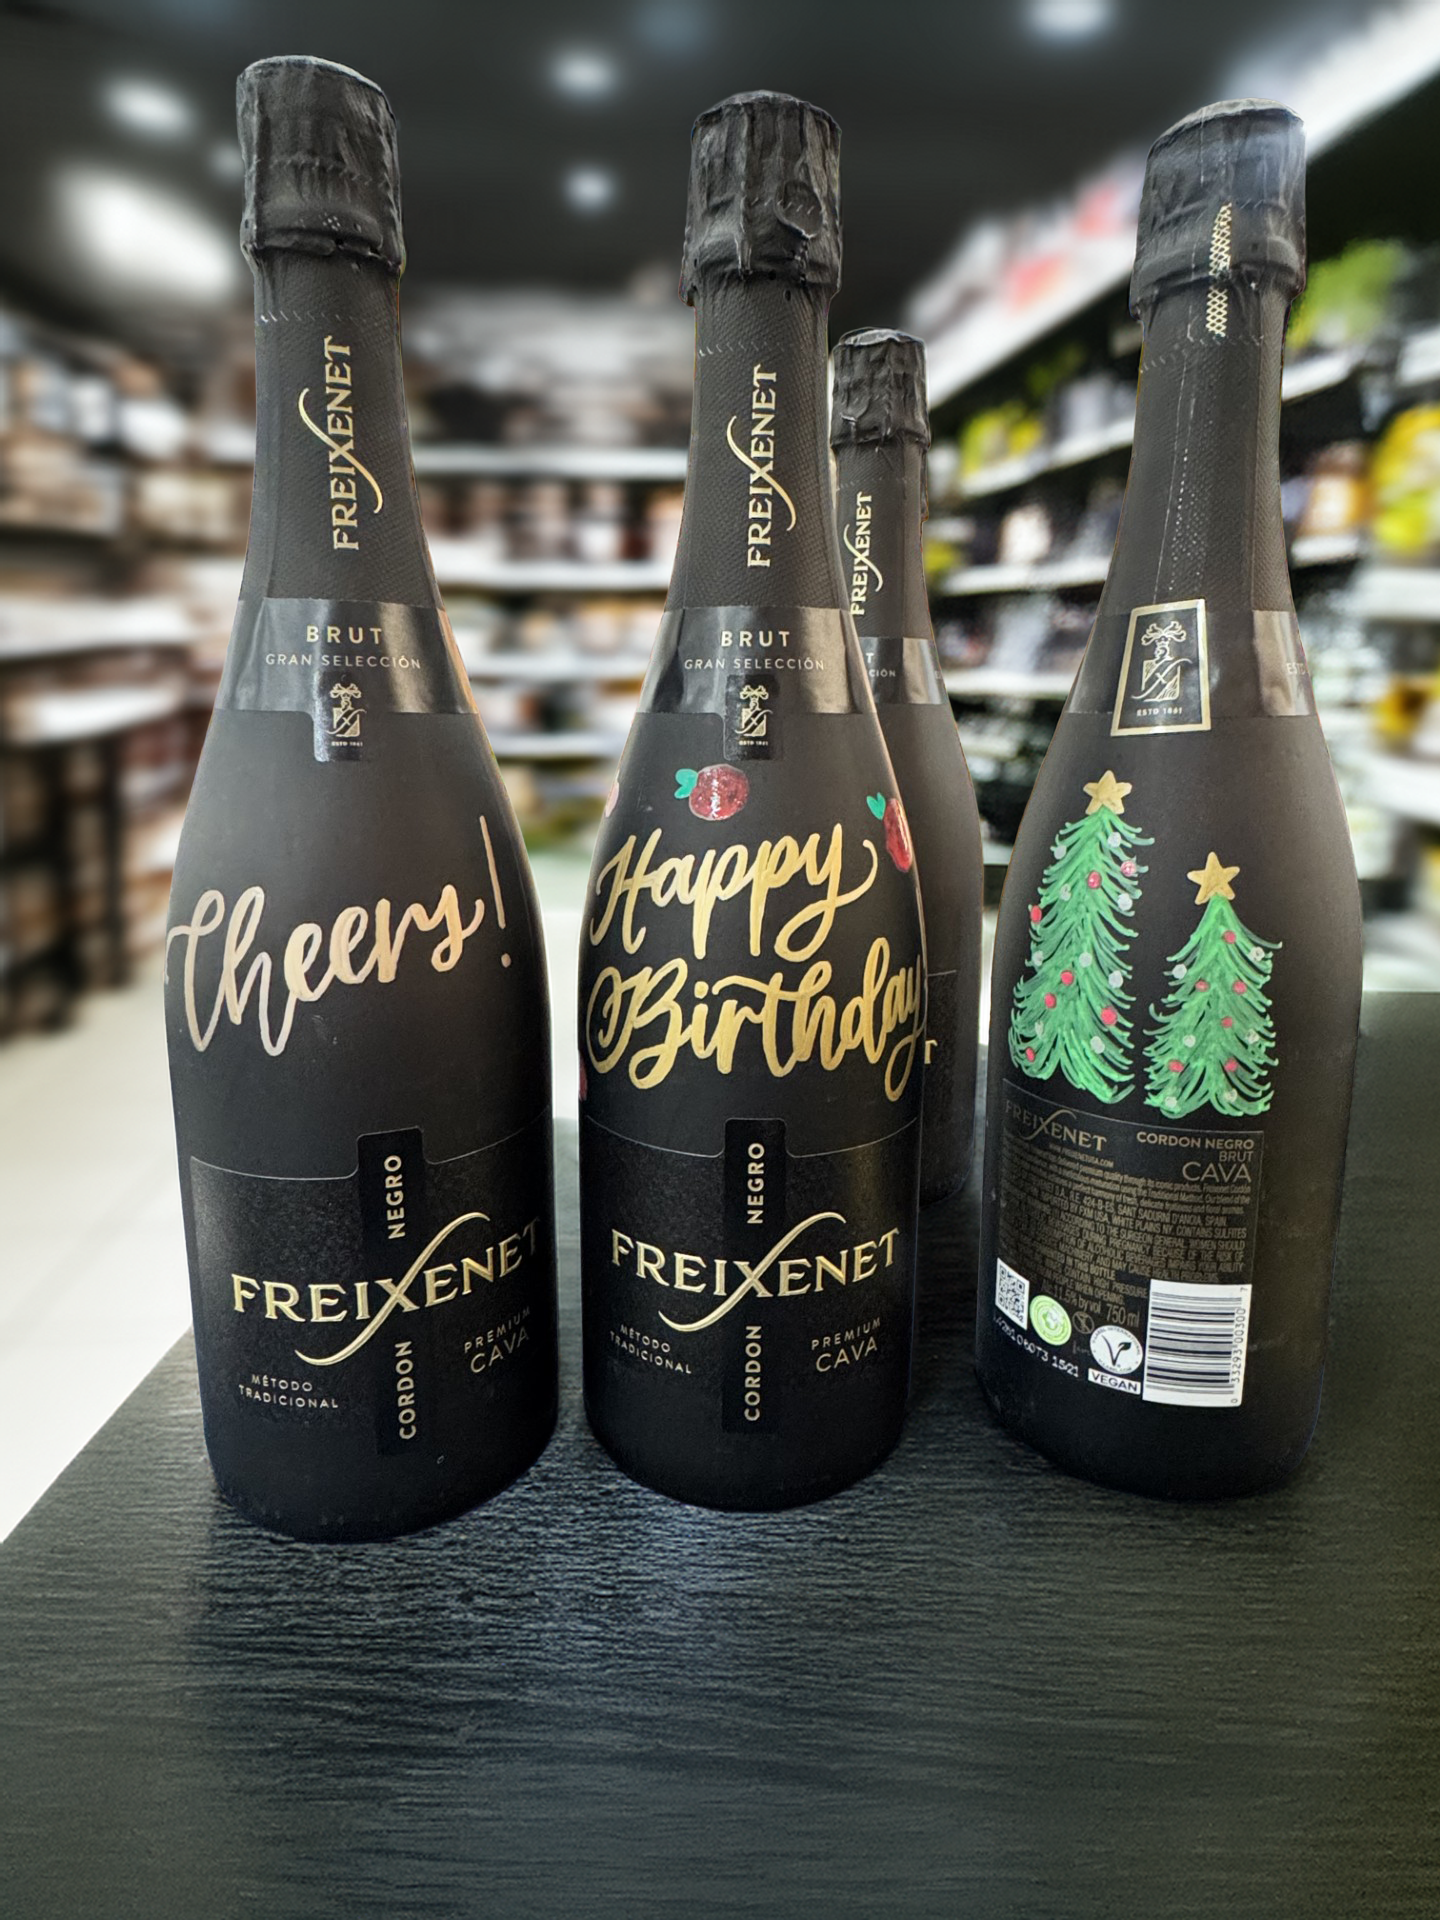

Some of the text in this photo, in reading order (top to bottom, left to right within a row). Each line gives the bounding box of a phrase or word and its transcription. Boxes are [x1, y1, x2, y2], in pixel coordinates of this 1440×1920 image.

[306, 625, 383, 645] BRUT
[721, 630, 791, 648] BRUT
[266, 653, 421, 670] GRAN SELECCIÓN
[684, 656, 825, 671] GRAN SELECCIÓN
[589, 823, 878, 963] Happy
[586, 937, 926, 1102] Birthday
[1005, 1099, 1108, 1152] FREIXENET
[1136, 1131, 1255, 1150] CORDON NEGRO
[1182, 1161, 1252, 1183] CAVA
[1219, 1150, 1254, 1162] BRUT
[384, 1155, 405, 1240] NEGRO
[747, 1143, 765, 1224] NEGRO
[231, 1212, 540, 1366] FREIXENET
[611, 1212, 899, 1332] FREIXENET
[464, 1306, 532, 1354] PREMIUM
[620, 1323, 671, 1353] MÉTODO
[811, 1317, 881, 1350] PREMIUM
[470, 1326, 529, 1374] CAVA
[610, 1331, 692, 1375] TRADICIONAL
[815, 1336, 879, 1373] CAVA
[252, 1374, 313, 1392] MÉTODO
[395, 1341, 416, 1440] CORDON
[744, 1325, 762, 1422] CORDON
[1092, 1370, 1138, 1392] VEGAN
[238, 1384, 339, 1409] TRADICIONAL
